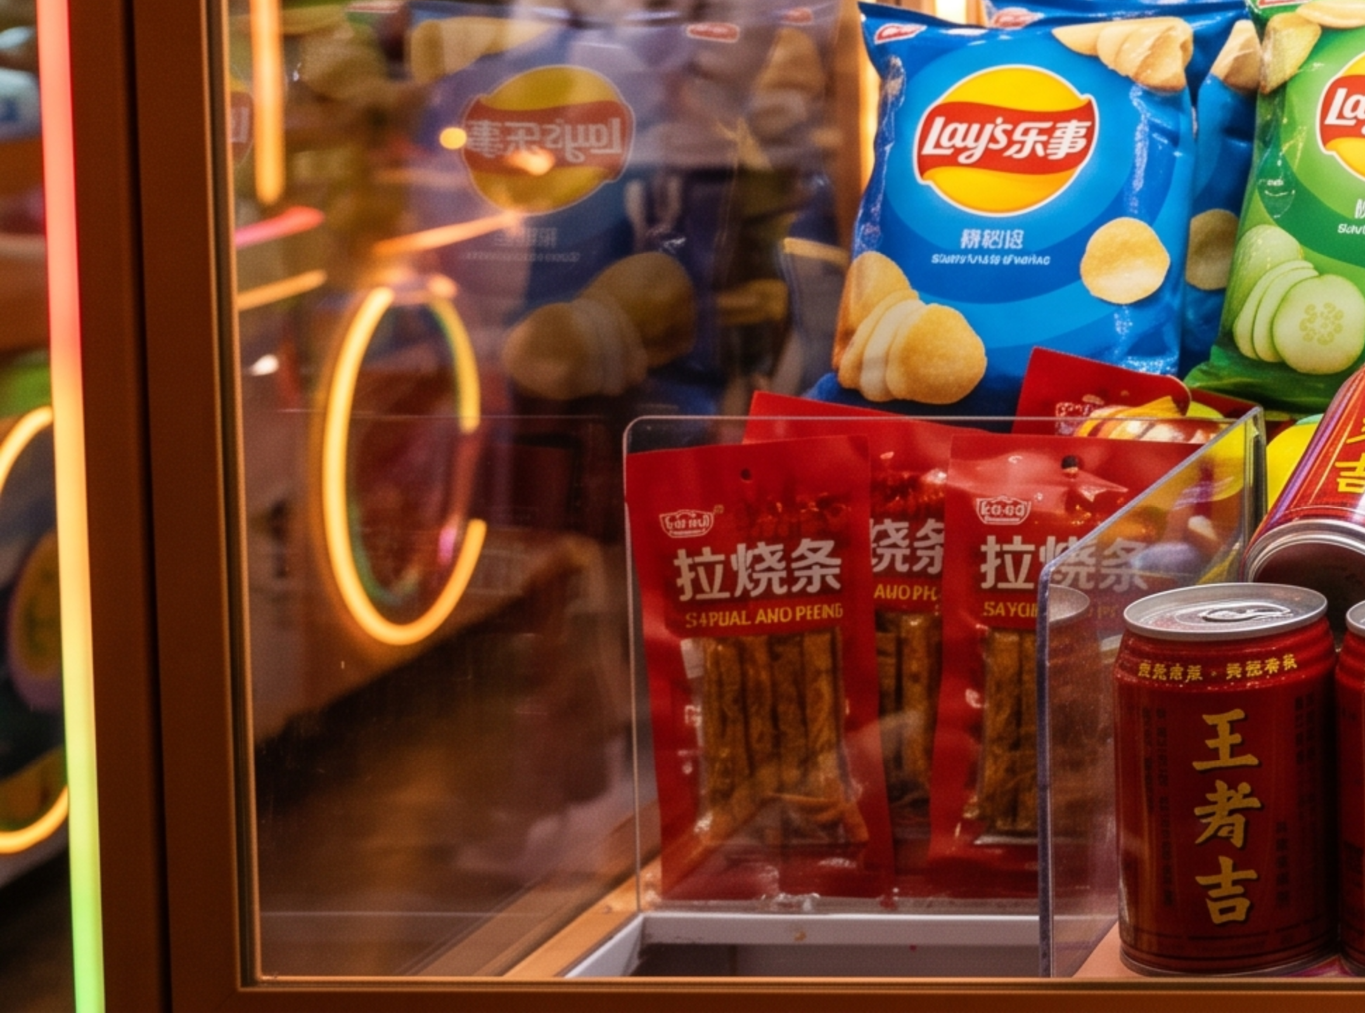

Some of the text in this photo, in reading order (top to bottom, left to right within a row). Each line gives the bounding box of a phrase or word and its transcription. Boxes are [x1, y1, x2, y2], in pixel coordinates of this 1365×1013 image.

[673, 538, 842, 601] 拉烧条
[1192, 708, 1262, 926] 王者吉
